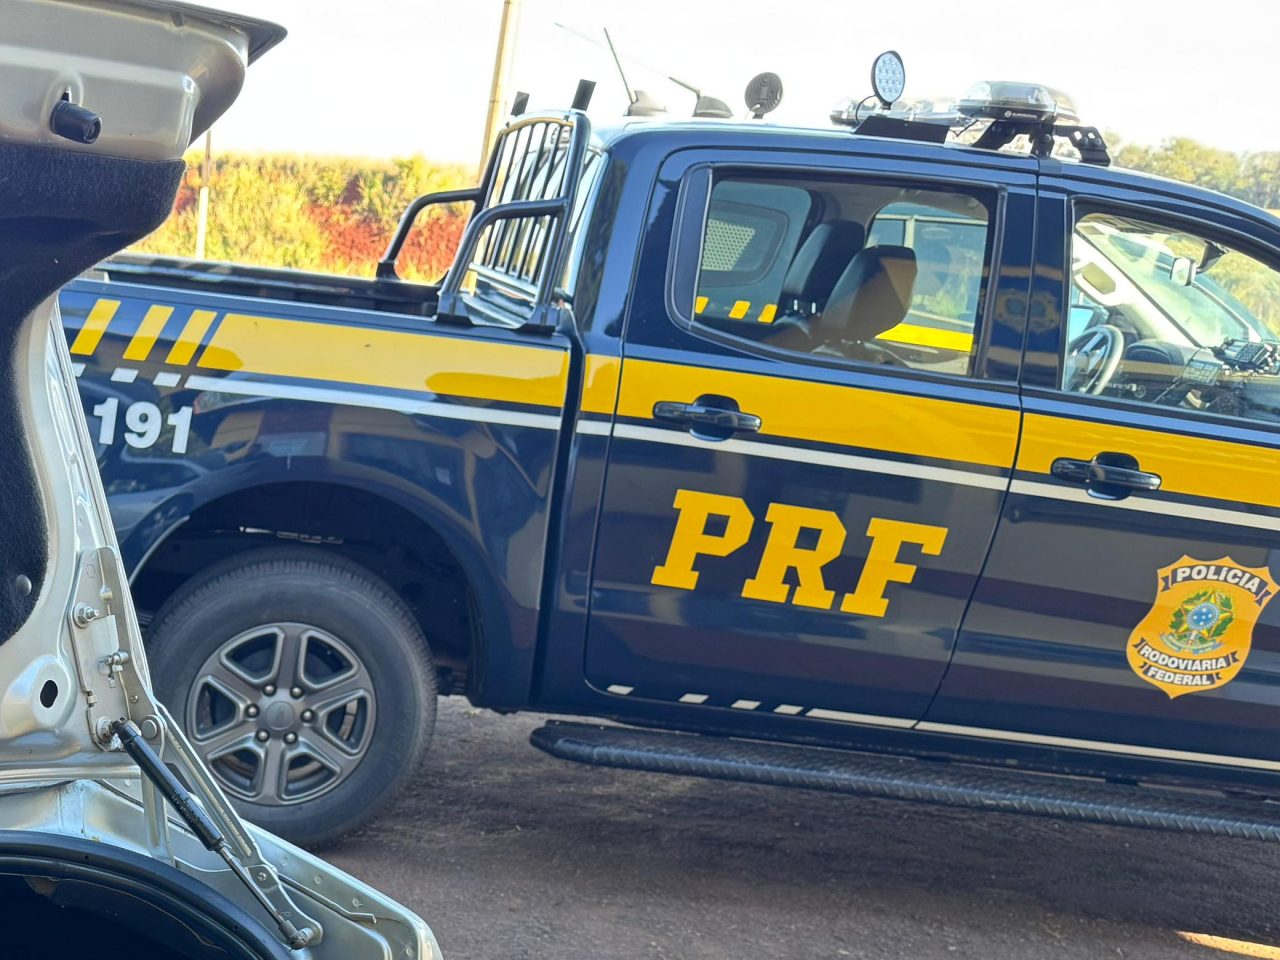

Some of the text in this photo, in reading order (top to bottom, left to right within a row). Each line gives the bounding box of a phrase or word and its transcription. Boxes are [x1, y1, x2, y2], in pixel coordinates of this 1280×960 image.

[93, 397, 193, 454] 191
[650, 488, 949, 617] PRF
[1147, 666, 1211, 685] FEDERAL
